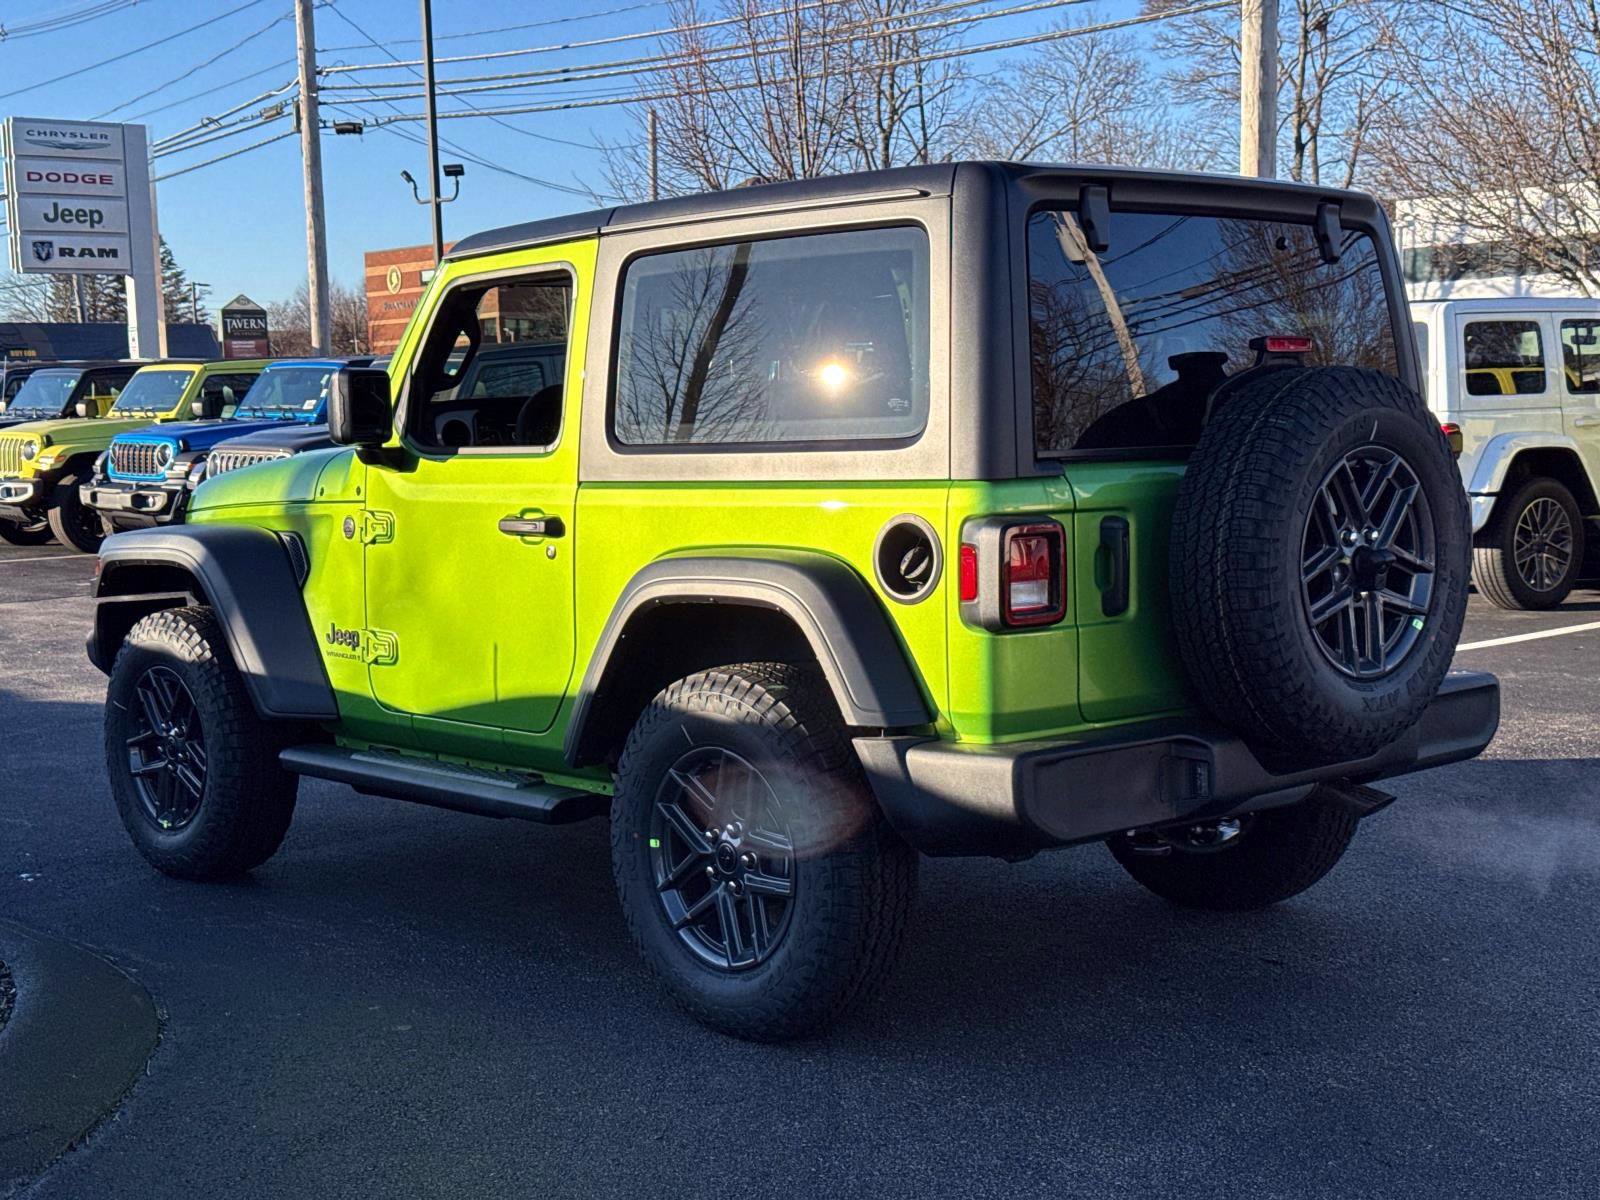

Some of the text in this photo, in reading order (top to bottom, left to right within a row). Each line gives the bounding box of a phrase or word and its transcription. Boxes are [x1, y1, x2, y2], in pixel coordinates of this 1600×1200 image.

[26, 129, 109, 141] CHRYSLER
[26, 171, 114, 185] DODGE
[43, 202, 104, 228] Jeep
[58, 246, 119, 258] RAM
[223, 317, 266, 334] TAVERN
[326, 623, 360, 651] Jeep
[326, 651, 358, 660] WRANGLER
